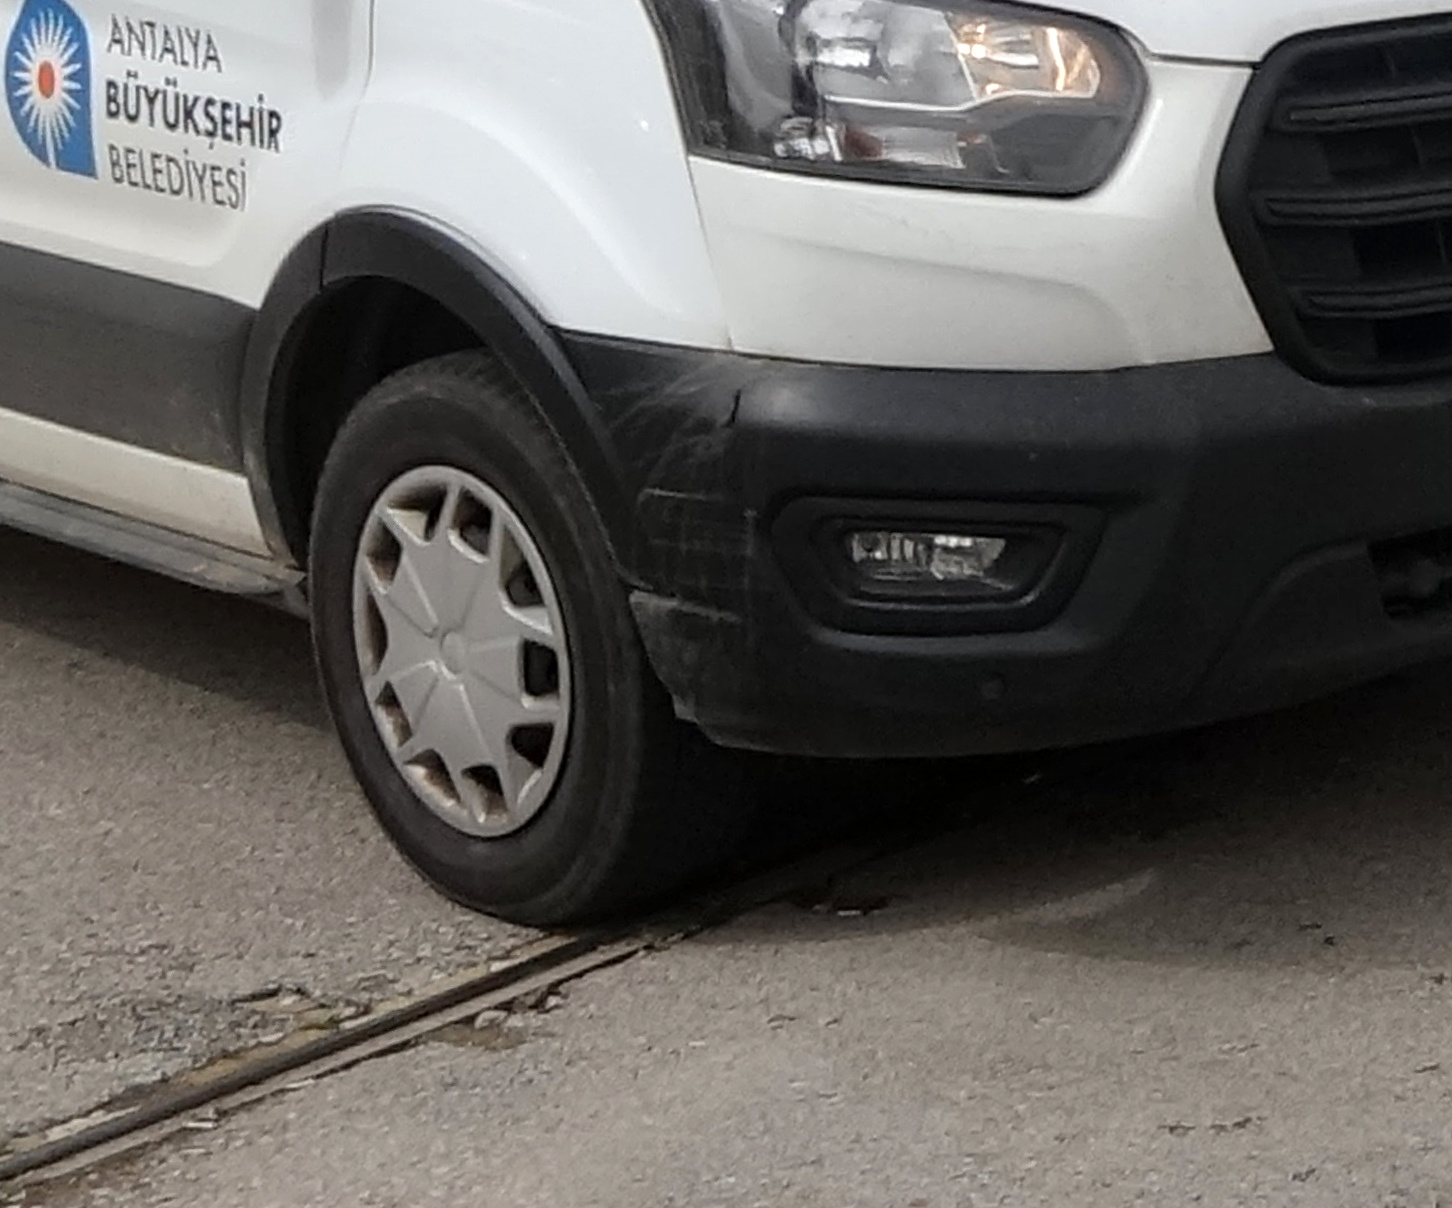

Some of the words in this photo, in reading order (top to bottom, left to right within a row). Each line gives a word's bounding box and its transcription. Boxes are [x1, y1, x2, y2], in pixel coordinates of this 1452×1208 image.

[107, 12, 223, 74] ANTALYA
[105, 68, 283, 153] BÜYÜKŞEHİR
[107, 142, 247, 211] BELEDİYESİ
